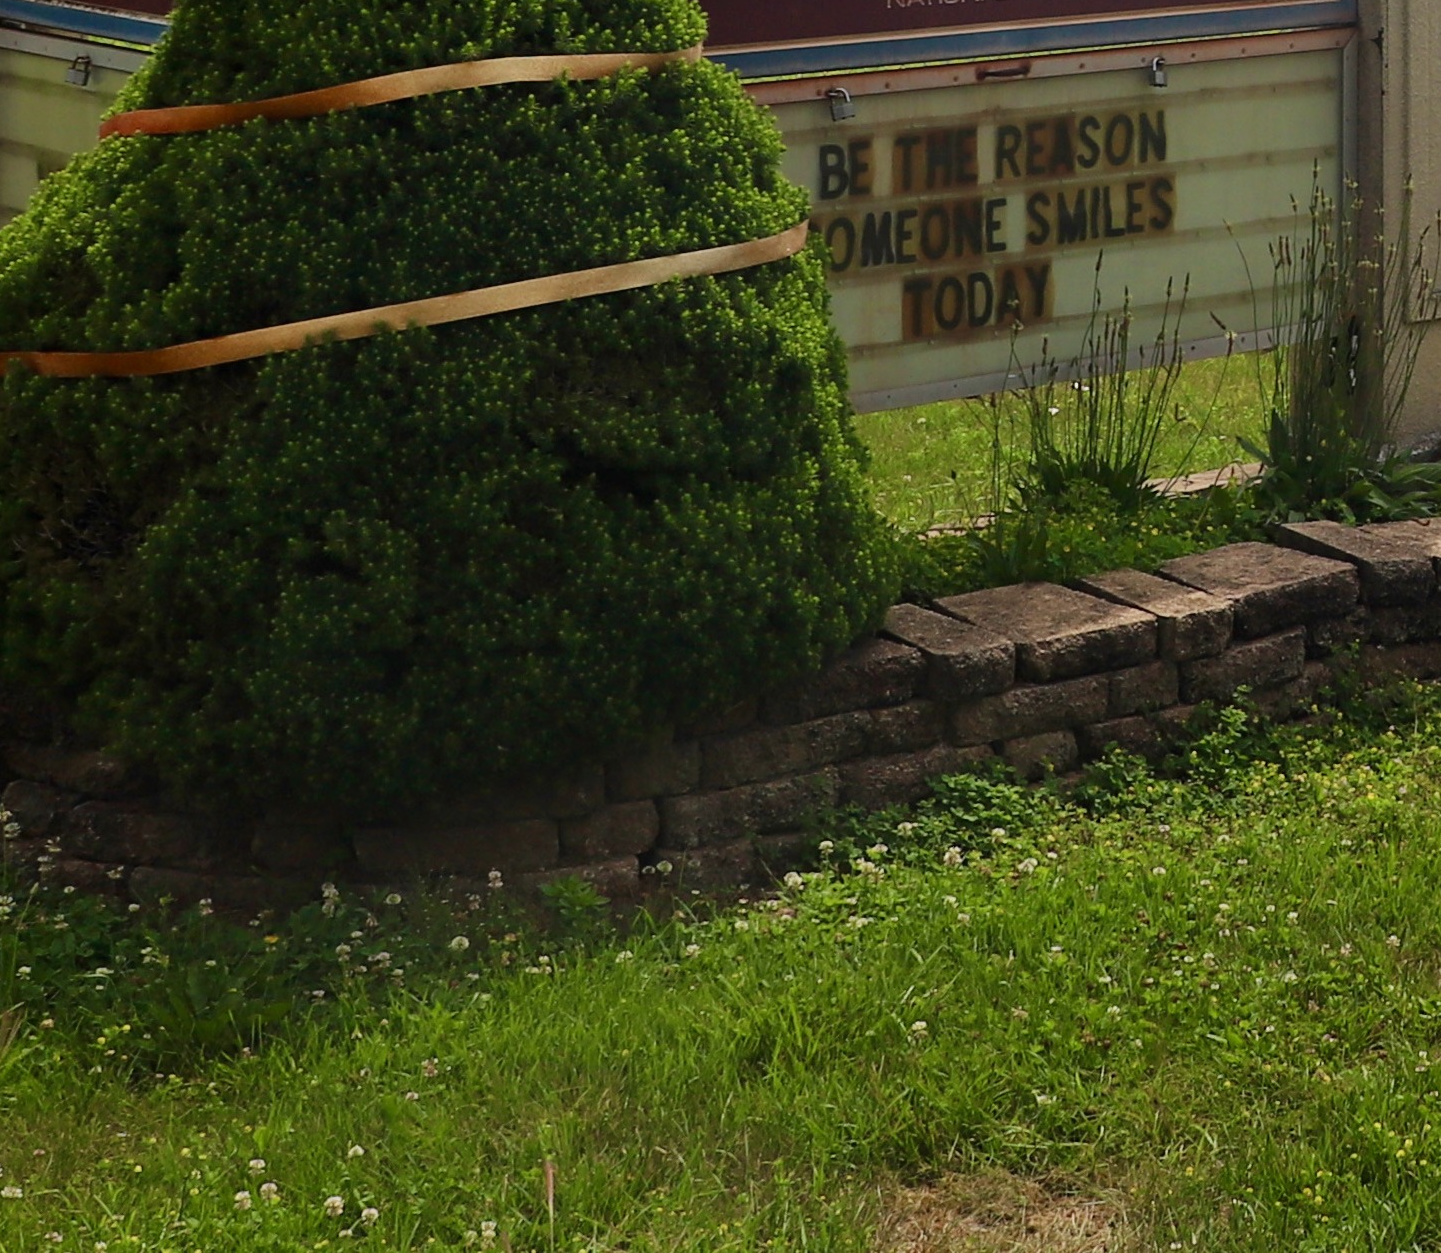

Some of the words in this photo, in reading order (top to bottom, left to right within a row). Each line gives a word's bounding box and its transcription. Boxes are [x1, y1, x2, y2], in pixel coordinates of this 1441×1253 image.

[819, 138, 873, 200] BE
[895, 126, 978, 194] THE
[996, 110, 1167, 179] REASON
[808, 198, 1007, 273] OMEONE
[1026, 177, 1173, 246] SMILES
[903, 262, 1051, 338] TODAY
